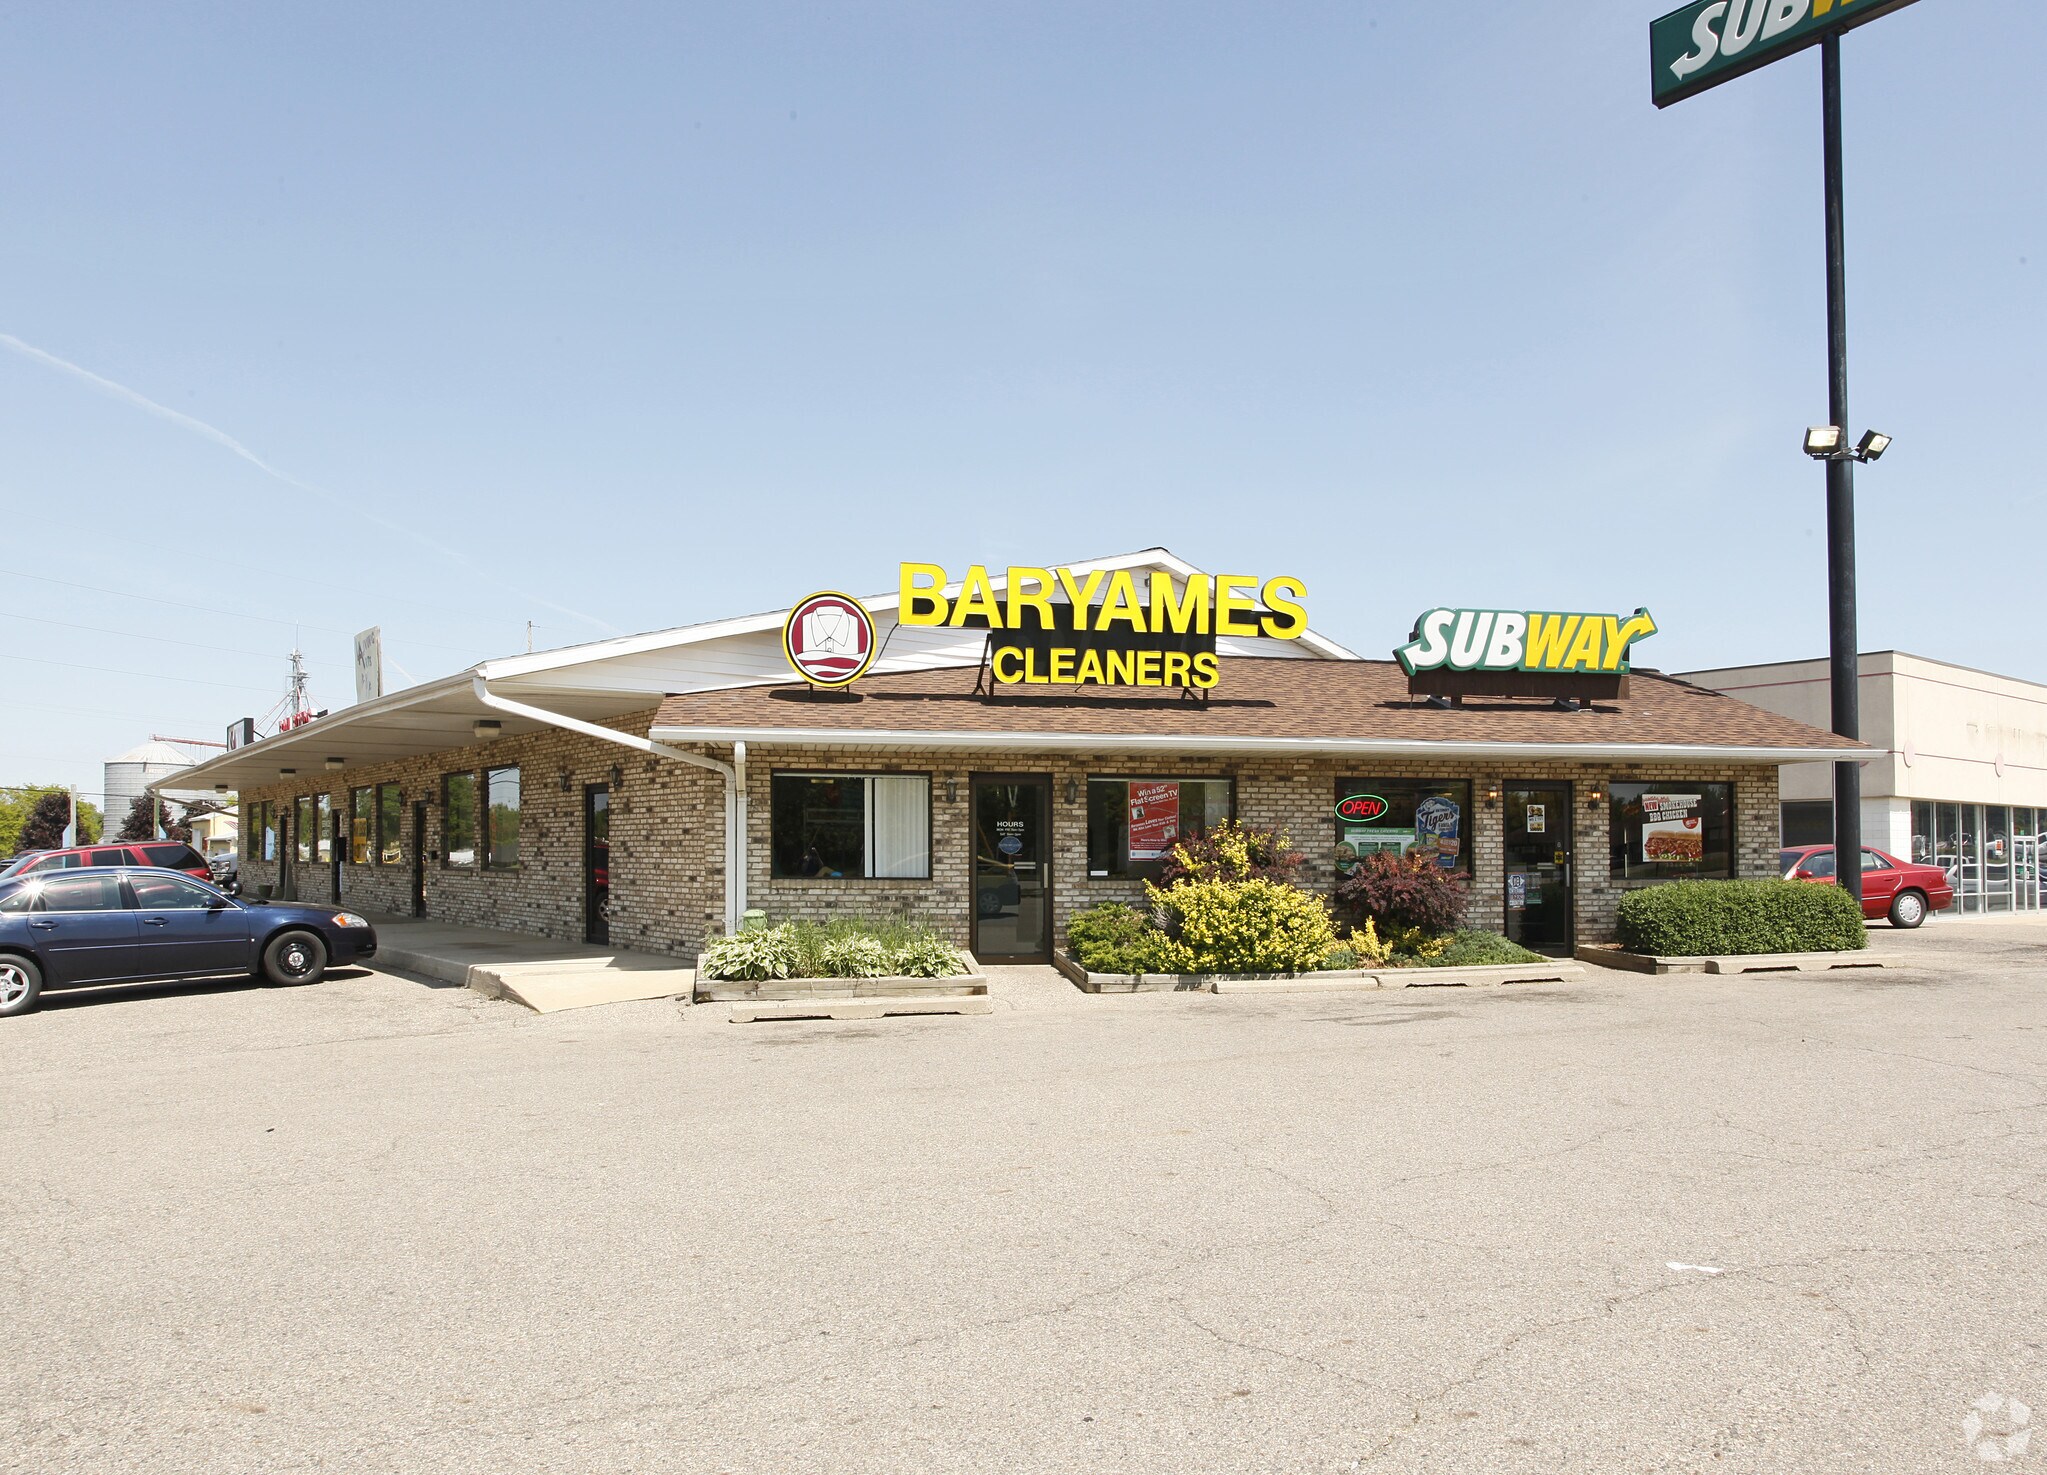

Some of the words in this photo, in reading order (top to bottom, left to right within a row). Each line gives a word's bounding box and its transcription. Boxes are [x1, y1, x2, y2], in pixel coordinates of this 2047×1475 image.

[1669, 0, 1854, 81] SUB
[899, 562, 1309, 640] BARYAMES
[1403, 609, 1656, 671] SUBWAY
[992, 645, 1220, 688] CLEANERS
[1130, 797, 1144, 806] Flat
[1144, 793, 1169, 803] Screen
[1168, 789, 1178, 797] TV
[1342, 800, 1381, 815] OPEN
[1644, 801, 1657, 811] NEW
[1660, 799, 1697, 811] SMOKEHOUSE
[1421, 810, 1455, 832] Tigers
[1649, 812, 1661, 822] BBQ
[1662, 809, 1688, 820] CHICKEN
